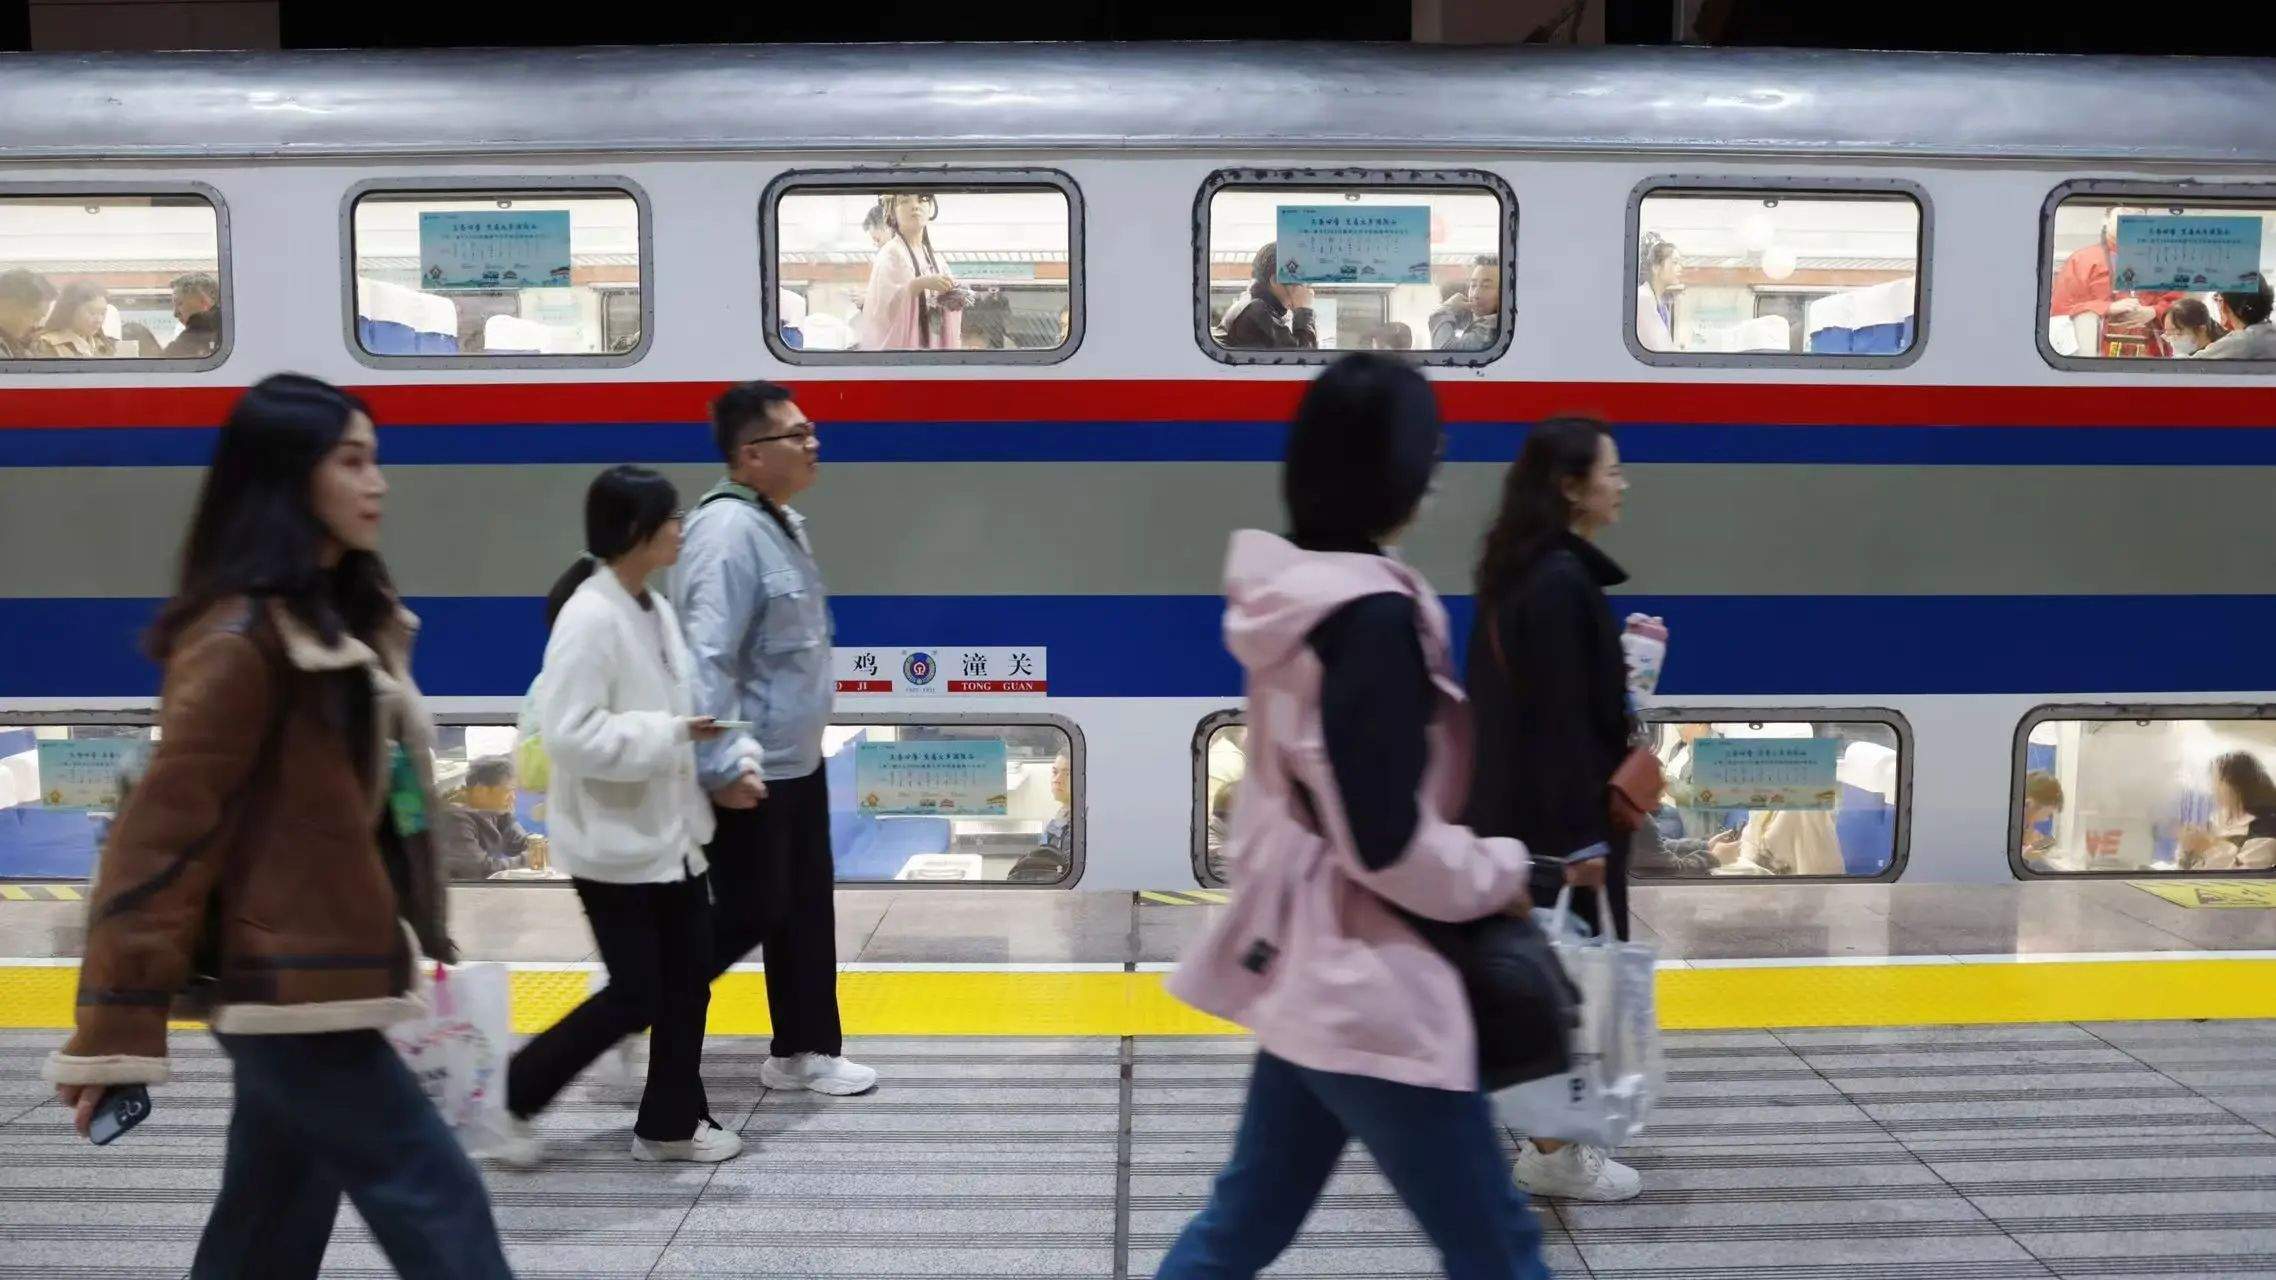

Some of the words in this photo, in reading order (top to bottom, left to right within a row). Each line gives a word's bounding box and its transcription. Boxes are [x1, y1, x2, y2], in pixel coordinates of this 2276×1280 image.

[853, 652, 878, 676] 鸡
[962, 652, 1033, 676] 潼关
[857, 681, 868, 691] JI
[961, 682, 992, 691] TONG
[1003, 682, 1034, 691] GUAN
